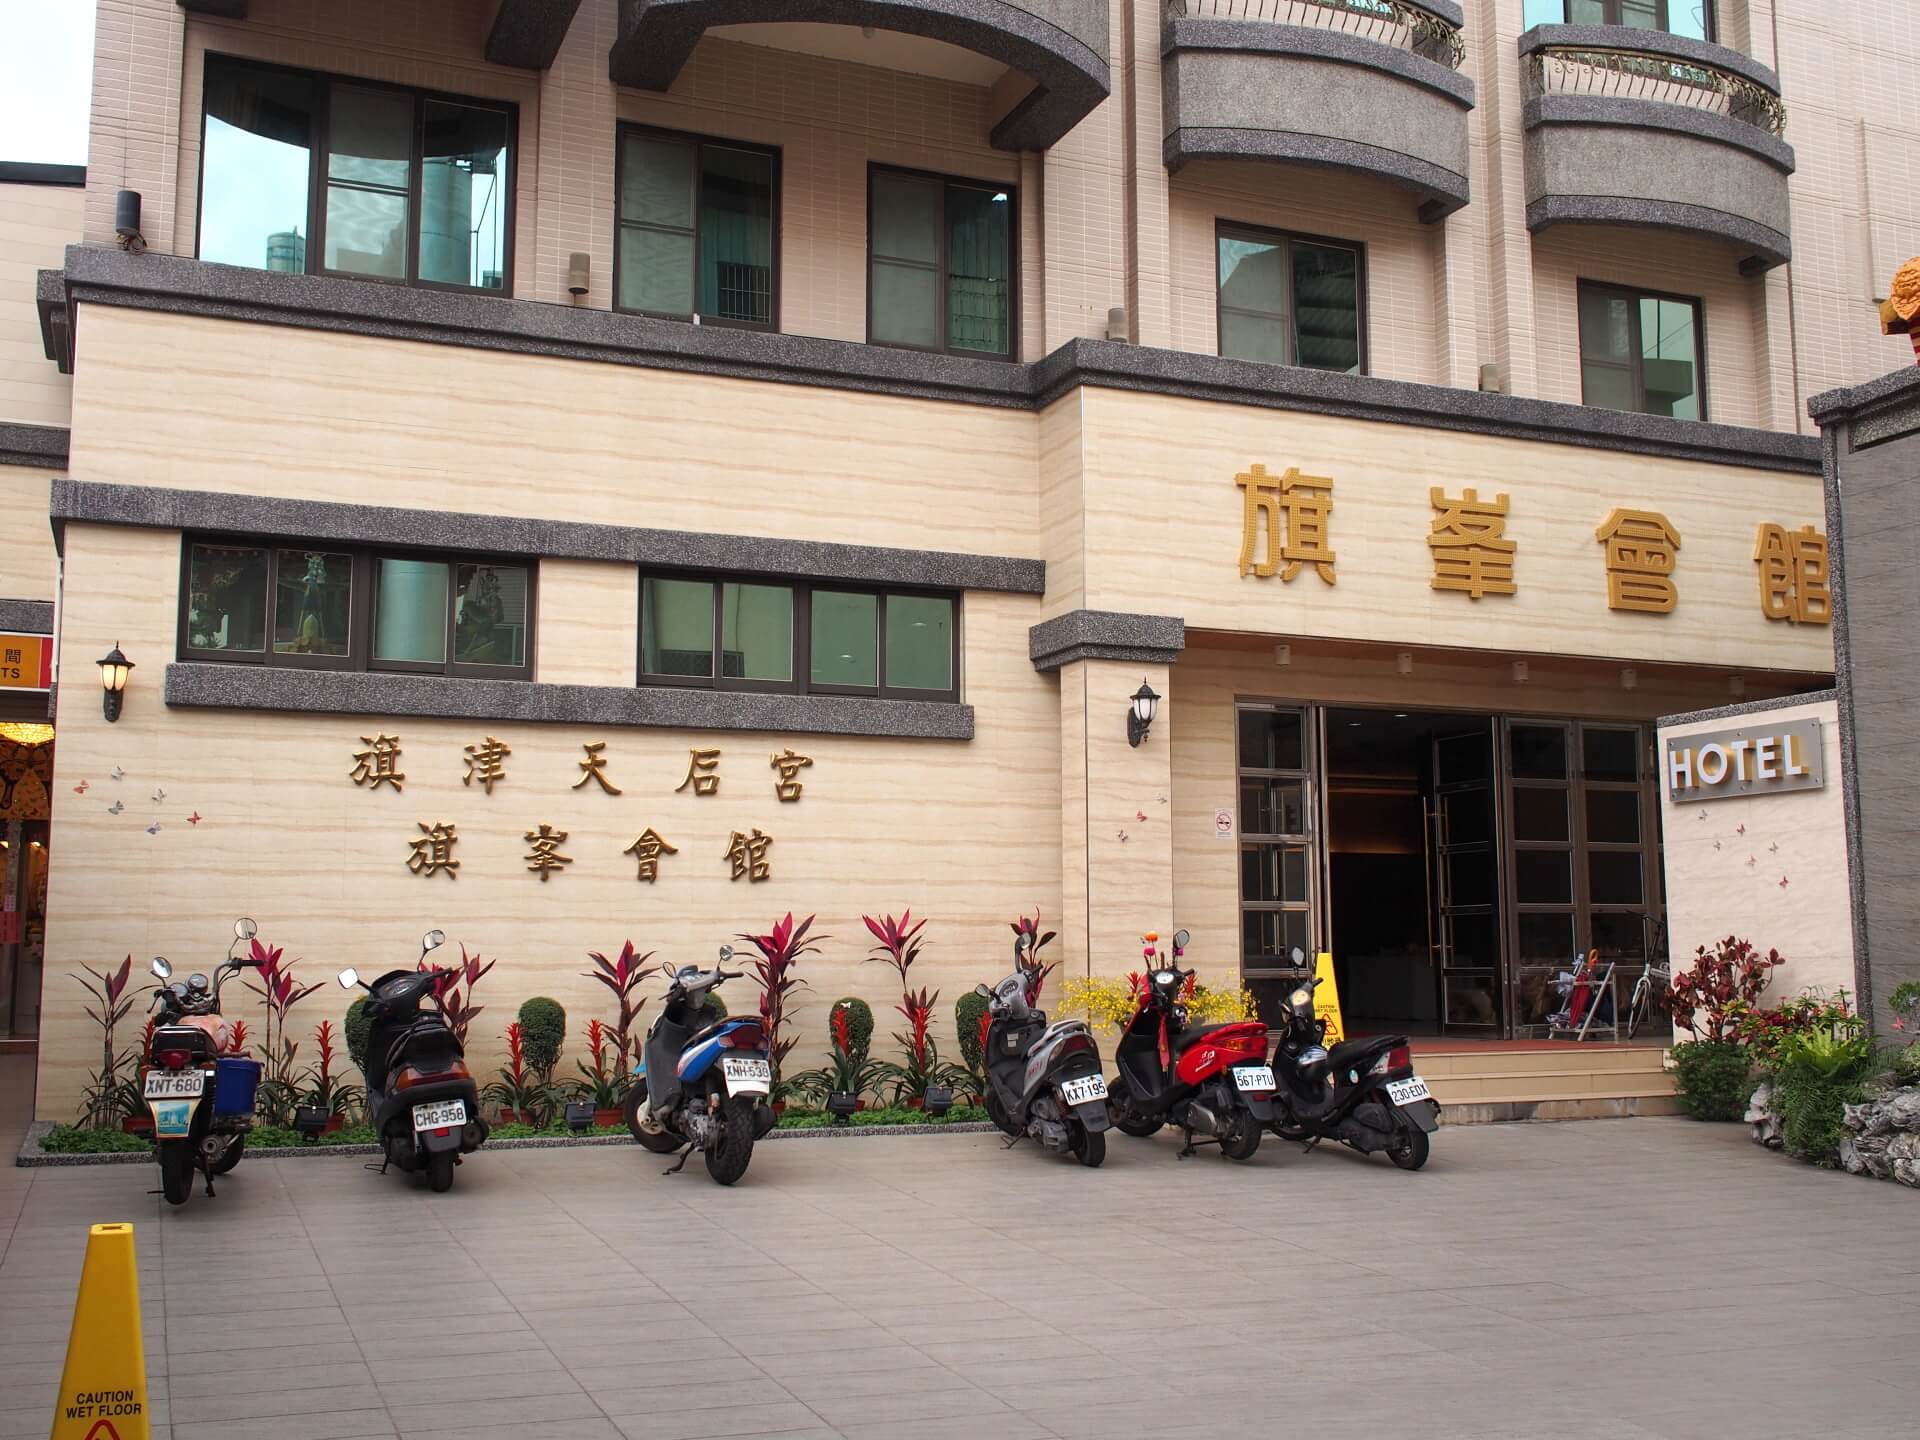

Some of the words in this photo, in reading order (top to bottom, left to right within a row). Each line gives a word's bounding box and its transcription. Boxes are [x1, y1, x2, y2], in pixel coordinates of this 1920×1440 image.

[5, 648, 21, 664] 間
[349, 732, 814, 802] 旗津天后宮
[1669, 734, 1809, 790] HOTEL
[146, 1078, 202, 1094] XNT-680
[1237, 1074, 1274, 1087] 567-PTU
[1065, 1081, 1106, 1102] KX7-195
[1391, 1083, 1429, 1102] 230-EDX
[415, 1107, 464, 1126] CHG-958
[77, 1390, 133, 1404] CAUTION
[67, 1406, 93, 1418] WET
[99, 1404, 141, 1416] FLOOR
